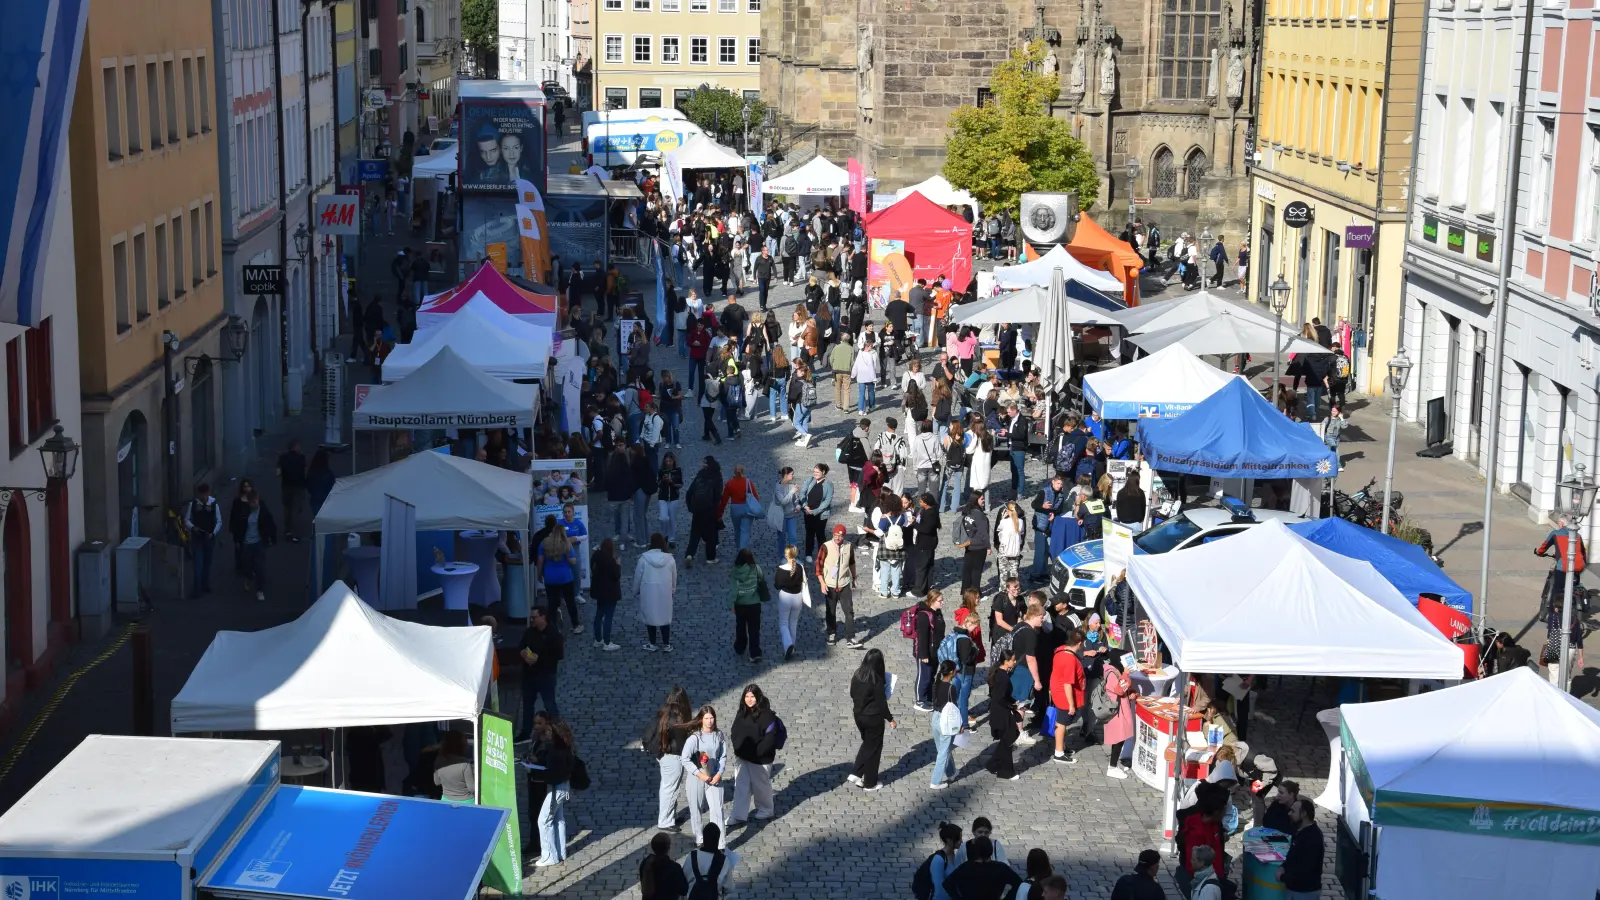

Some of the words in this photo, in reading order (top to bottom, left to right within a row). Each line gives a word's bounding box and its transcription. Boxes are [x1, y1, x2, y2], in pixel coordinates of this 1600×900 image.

[321, 203, 355, 226] H&M
[1346, 232, 1371, 242] liberty
[246, 269, 281, 281] MATT
[250, 283, 277, 292] optik
[368, 414, 453, 427] Hauptzollamt
[457, 414, 517, 426] Nürnberg
[1157, 453, 1239, 470] Polizeipräsidium
[1241, 462, 1310, 471] Mittelfranken
[31, 880, 57, 892] IHK
[328, 868, 360, 896] JETZT
